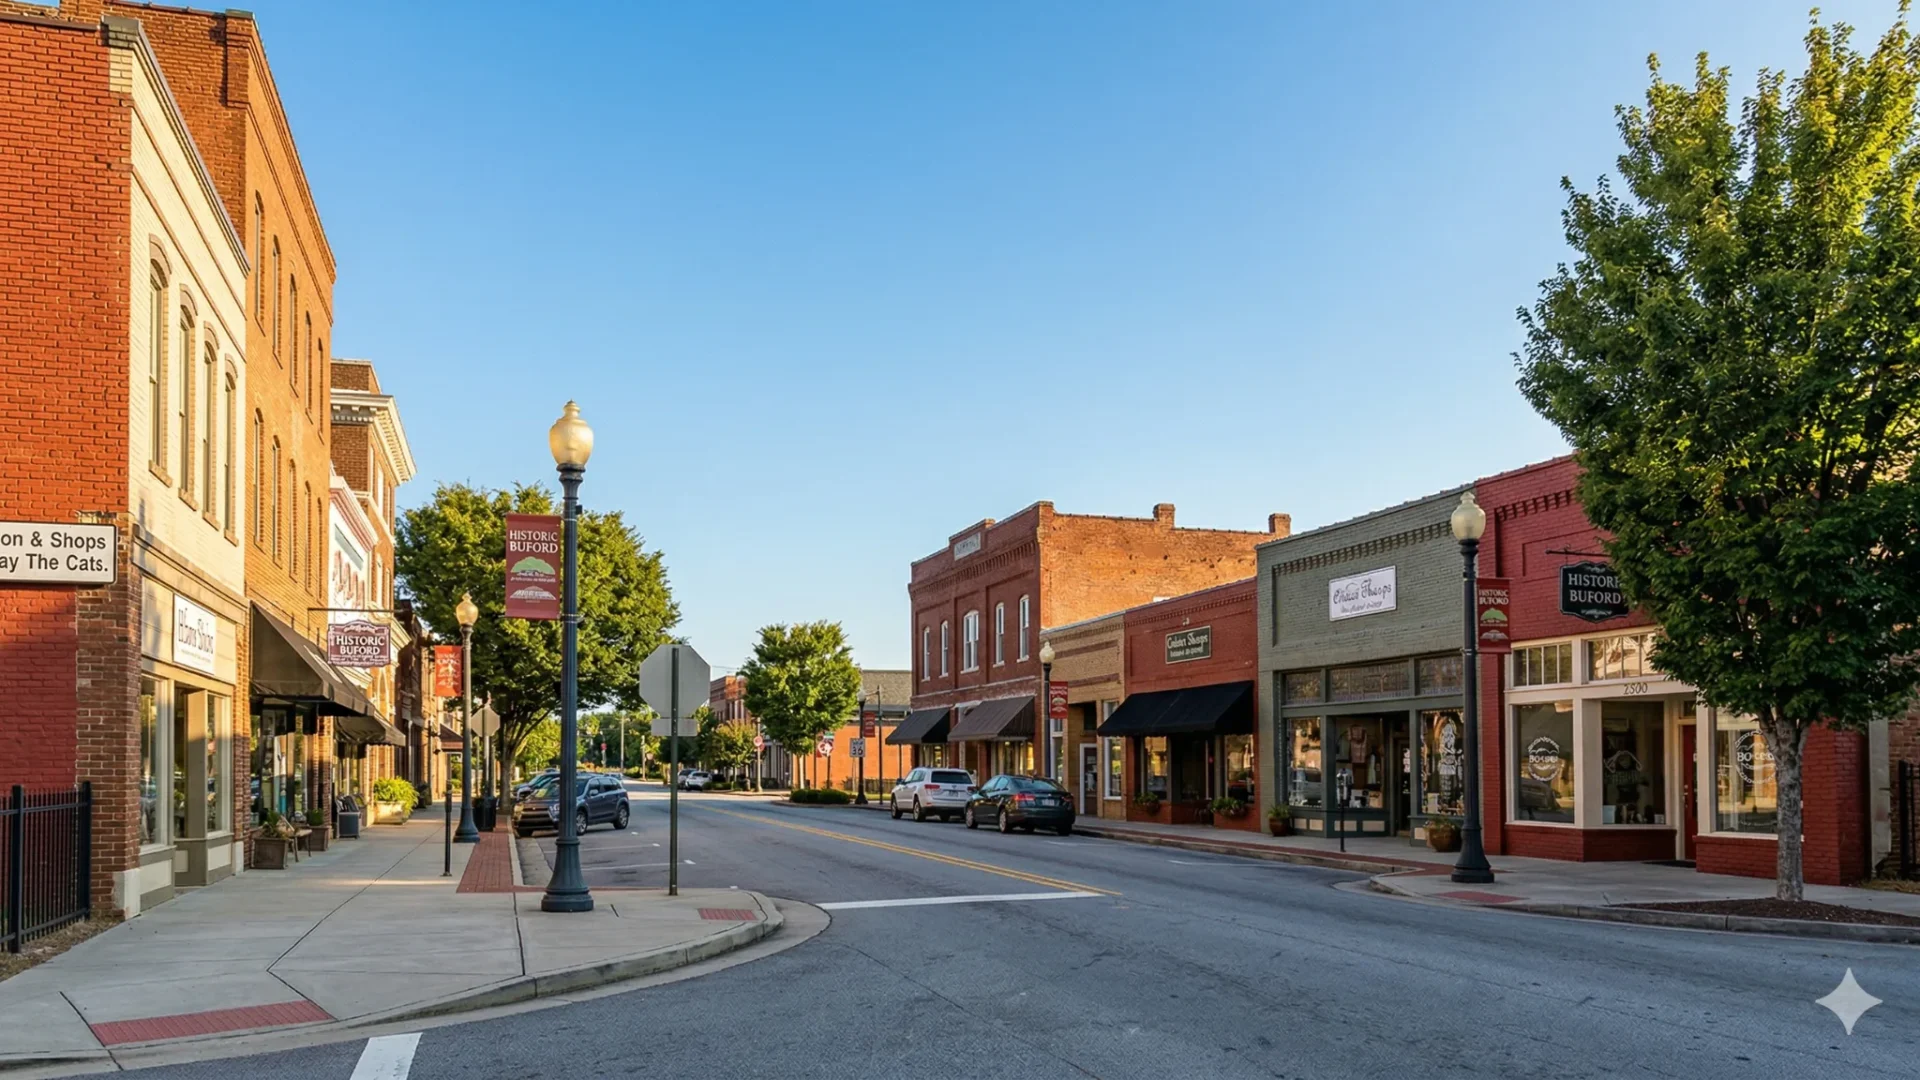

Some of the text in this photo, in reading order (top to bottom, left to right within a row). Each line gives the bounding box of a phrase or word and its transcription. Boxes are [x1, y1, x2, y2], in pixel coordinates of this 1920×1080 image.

[0, 531, 106, 553] on & Shops
[509, 529, 558, 542] HISTORIC
[509, 541, 559, 554] BUFORD
[25, 553, 59, 570] The
[66, 554, 108, 572] Cats.
[1568, 573, 1620, 588] HISTORI
[1570, 589, 1621, 604] BUFORD
[336, 635, 385, 646] HISTORIC
[340, 645, 381, 655] BUFORD
[1624, 682, 1648, 695] 2500
